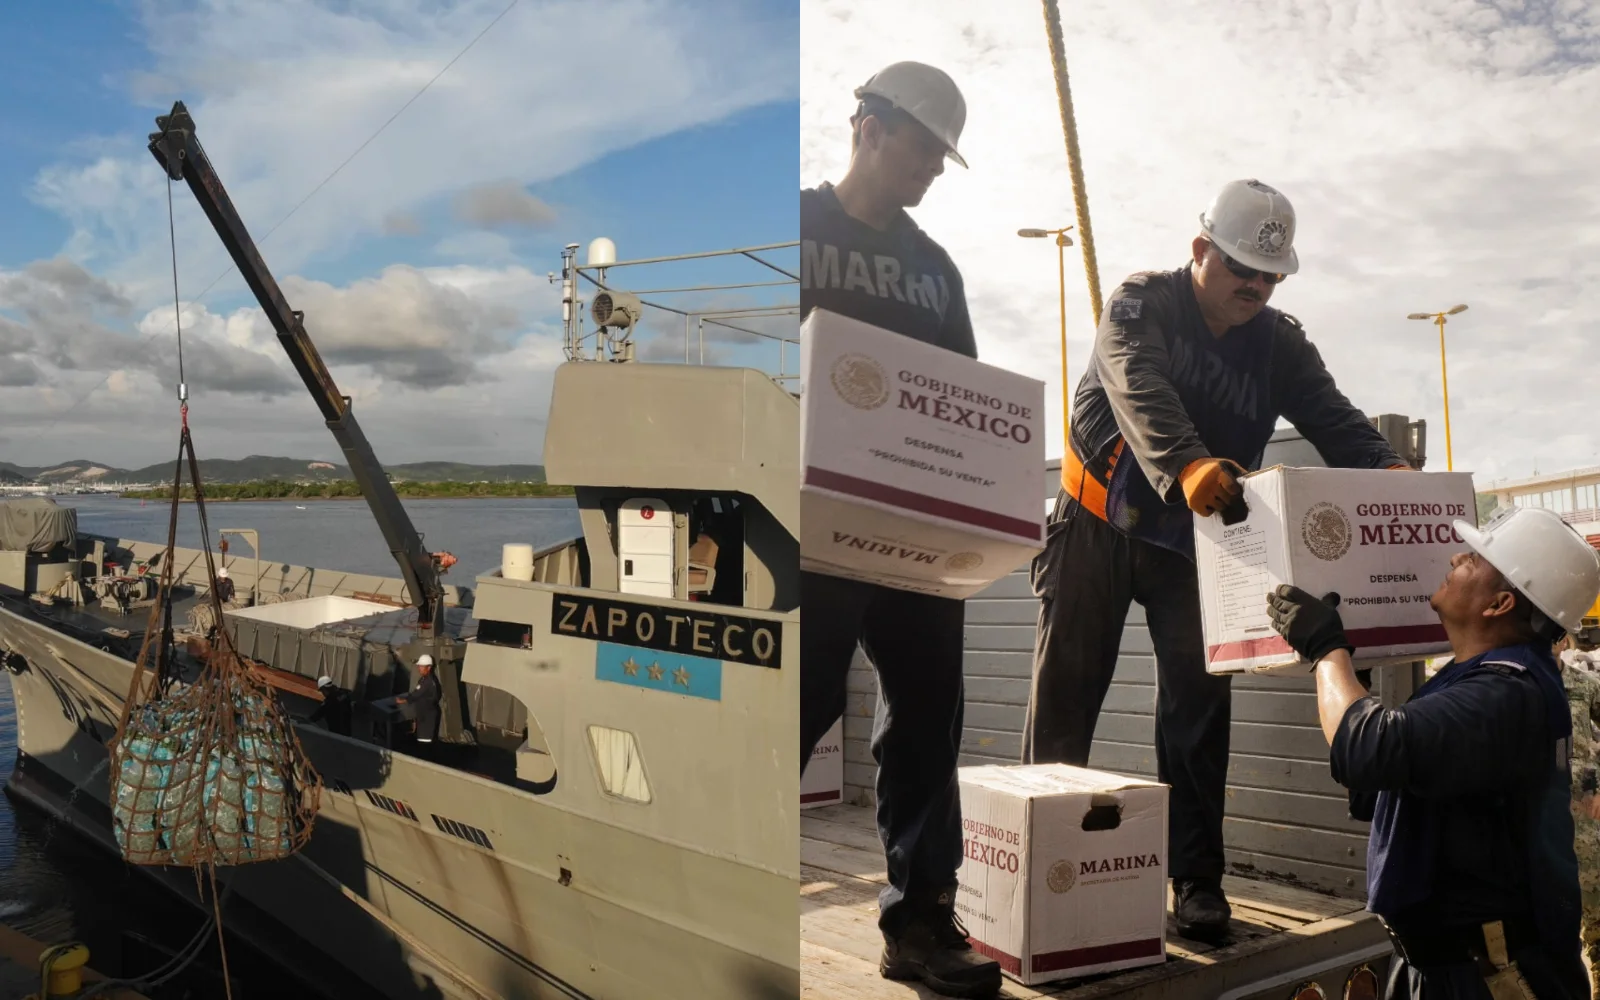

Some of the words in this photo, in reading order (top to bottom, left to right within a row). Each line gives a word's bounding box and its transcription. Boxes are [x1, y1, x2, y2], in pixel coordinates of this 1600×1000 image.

[897, 369, 1003, 410] GOBIERNO
[1007, 401, 1032, 420] DE
[897, 389, 1032, 444] MÉXICO
[904, 436, 965, 460] DESPENSA
[938, 466, 953, 477] SU
[1356, 503, 1443, 518] GOBIERNO
[1445, 503, 1466, 517] DE
[831, 530, 940, 565] MARINA
[1369, 573, 1419, 583] DESPENSA
[1399, 595, 1411, 604] SU
[558, 601, 776, 660] ZAPOTECO
[813, 744, 840, 755] RINA
[962, 818, 1004, 842] OBIERNO
[1006, 830, 1020, 846] DE
[1079, 853, 1161, 876] MARINA
